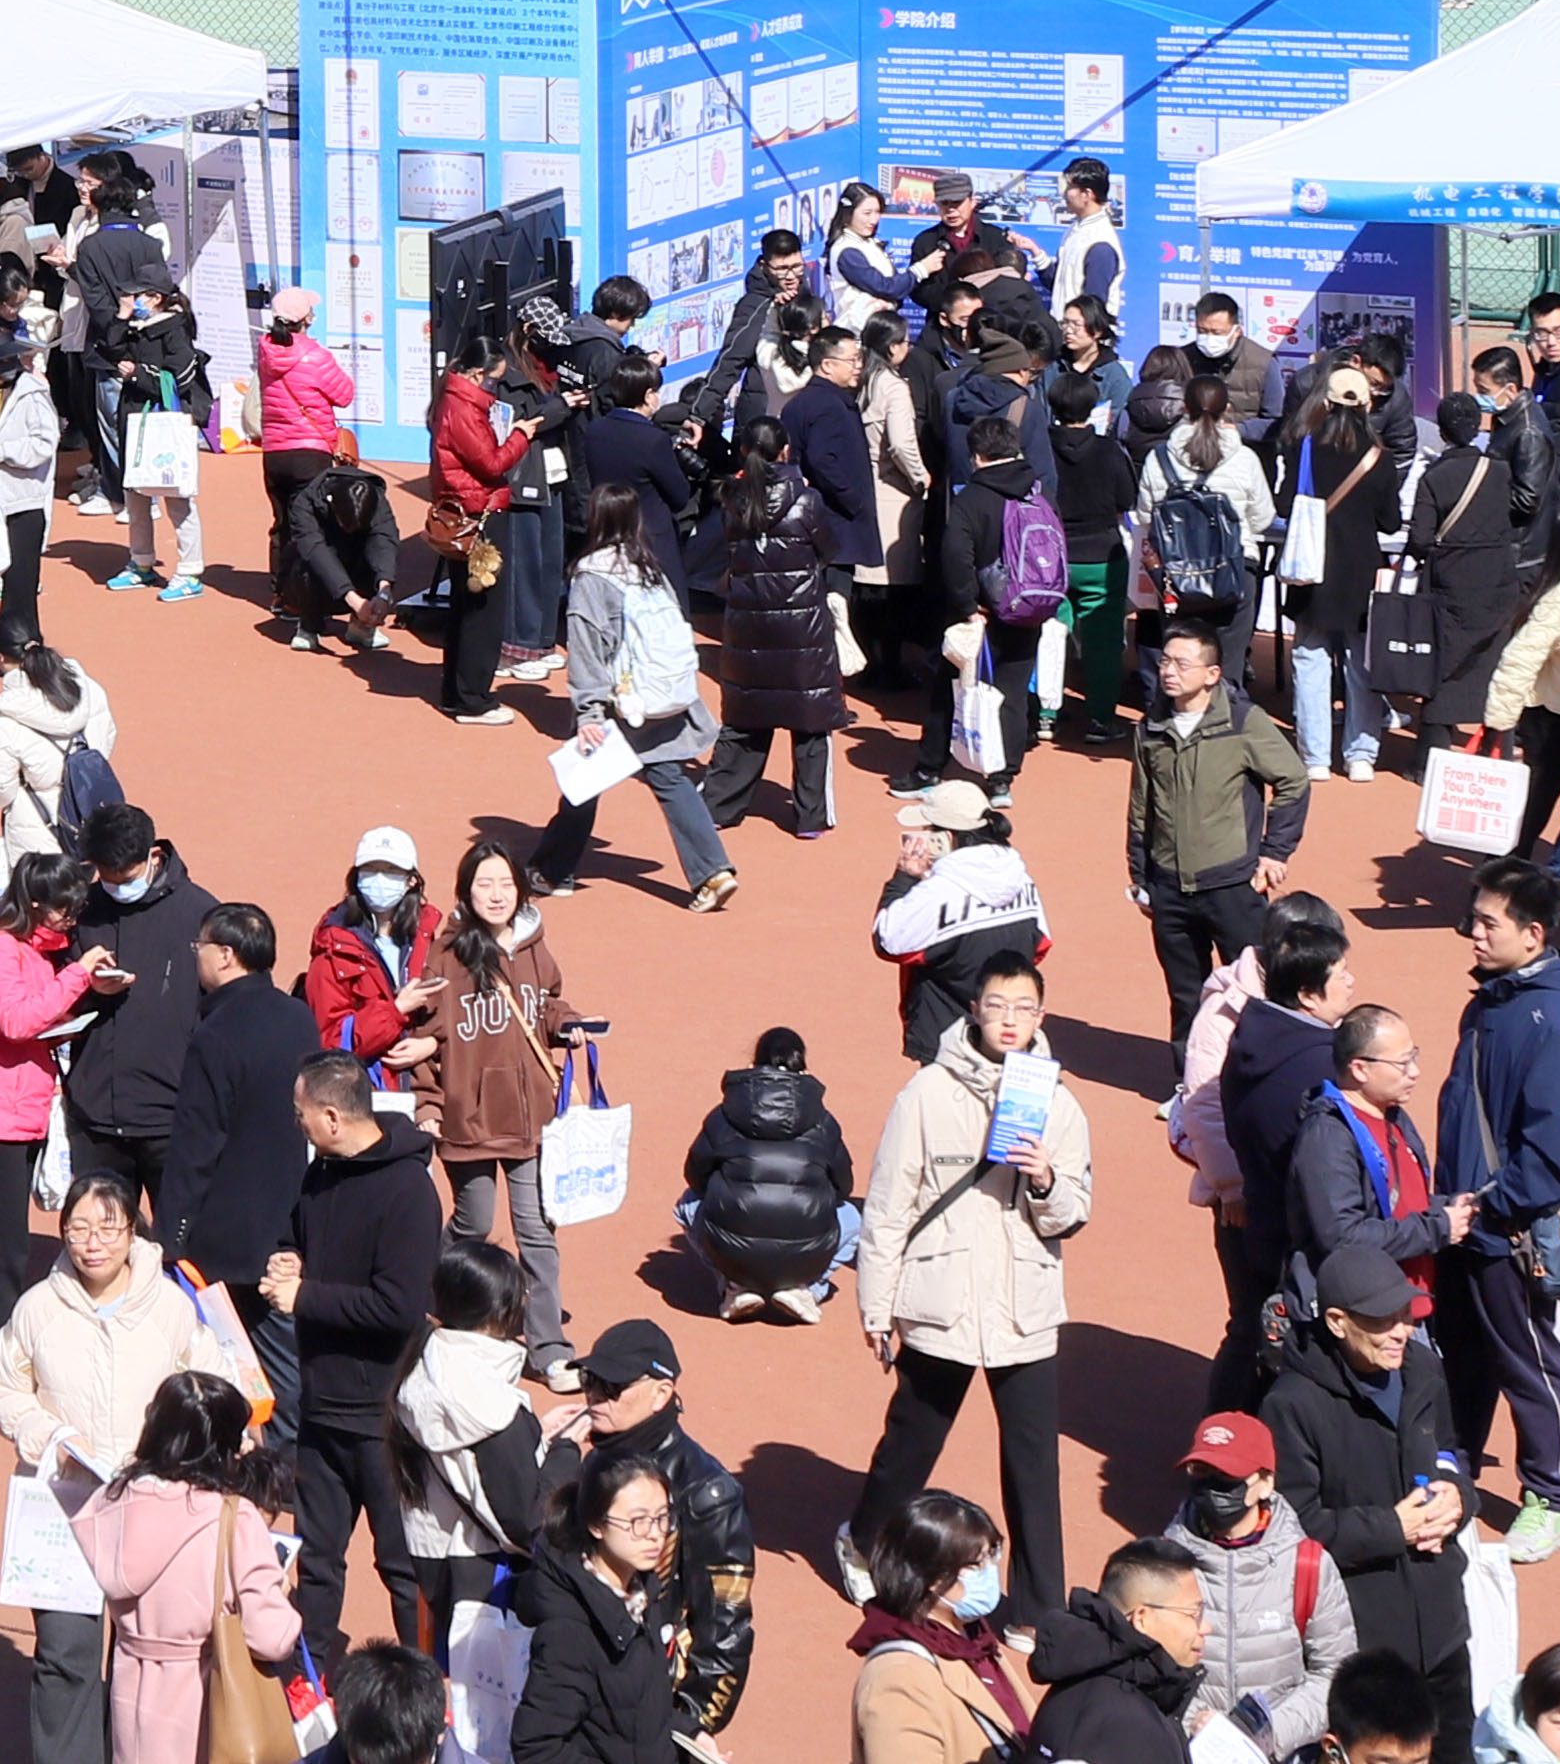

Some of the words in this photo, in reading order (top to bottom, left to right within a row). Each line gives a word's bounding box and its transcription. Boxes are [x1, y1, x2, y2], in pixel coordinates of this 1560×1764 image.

[895, 10, 956, 29] 学院介绍
[1443, 766, 1477, 781] From
[1480, 771, 1509, 788] Here
[1442, 779, 1464, 793] You
[1468, 783, 1486, 797] Go
[1441, 794, 1503, 813] Anywhere
